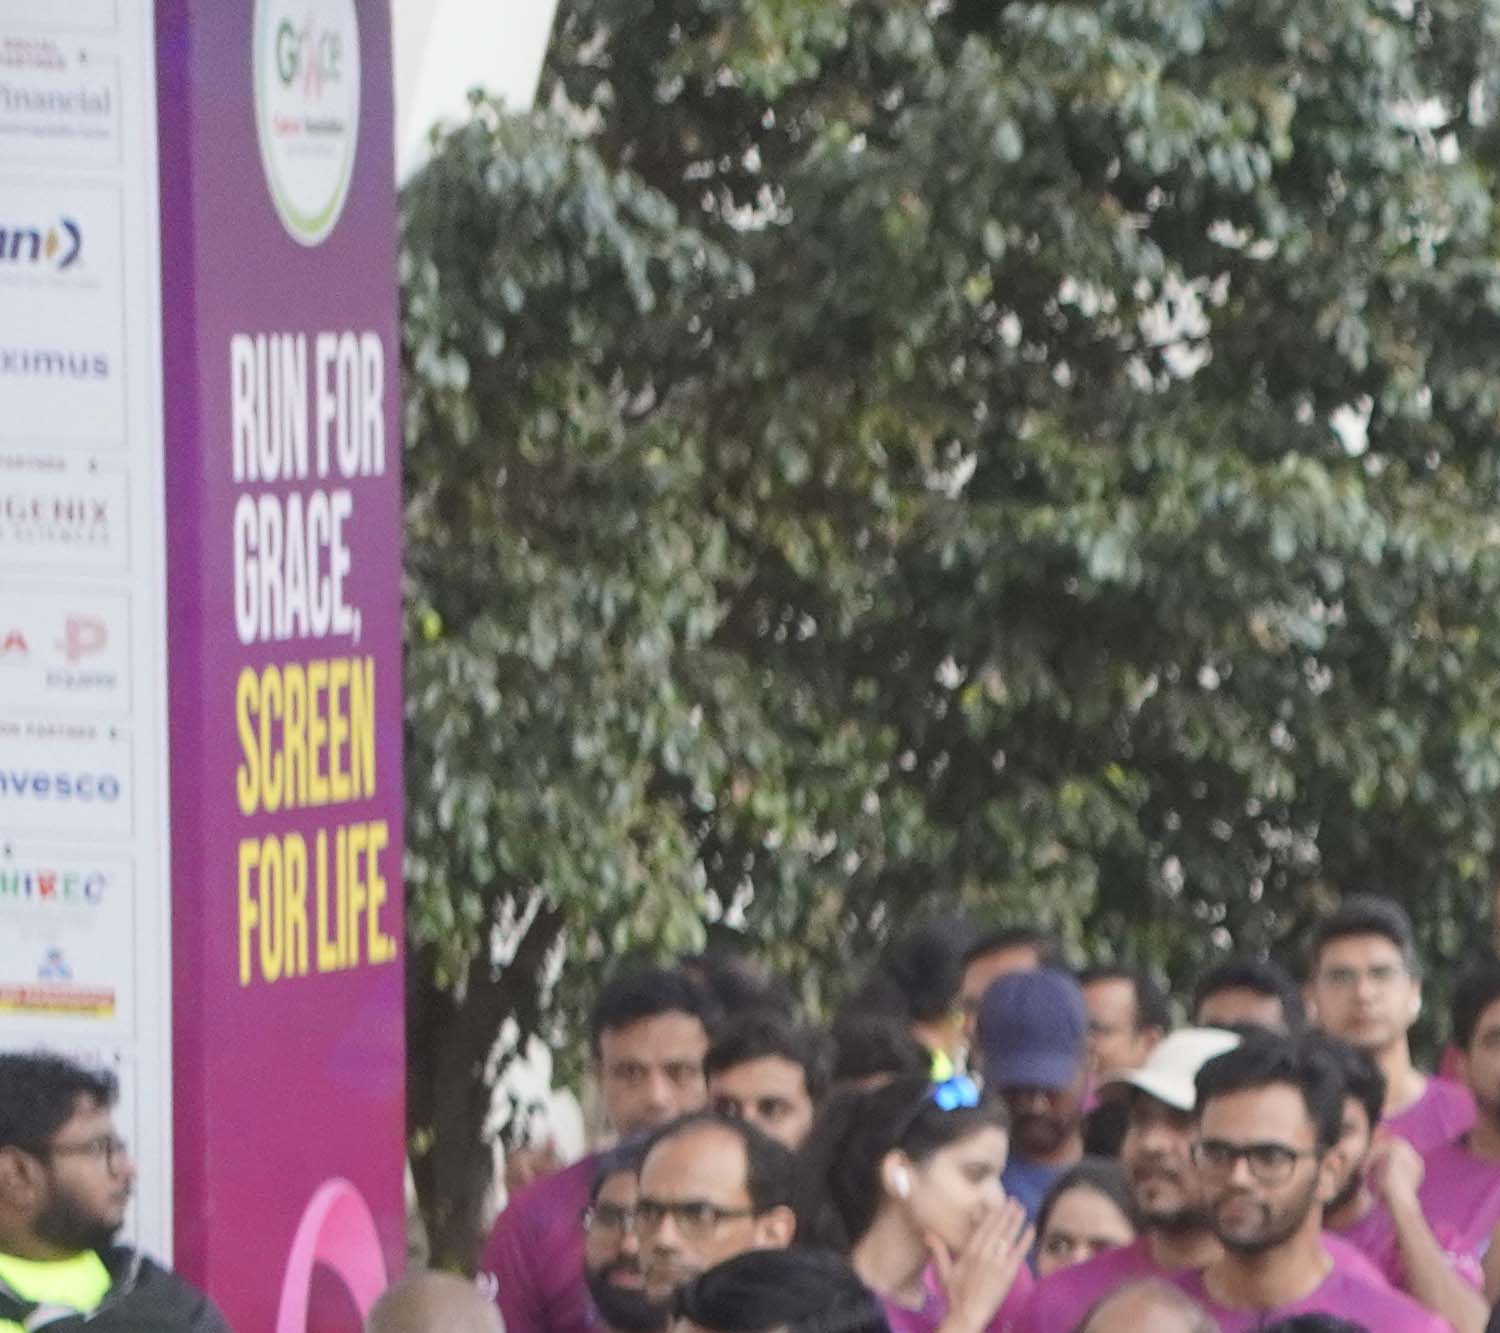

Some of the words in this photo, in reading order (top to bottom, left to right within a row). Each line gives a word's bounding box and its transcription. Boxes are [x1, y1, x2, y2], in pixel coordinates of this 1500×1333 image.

[231, 331, 308, 482] RUN
[316, 331, 386, 478] FOR
[233, 488, 361, 645] GRACE,
[236, 655, 376, 817] SCREEN
[238, 831, 308, 987] FOR
[316, 819, 398, 972] LIFE.
